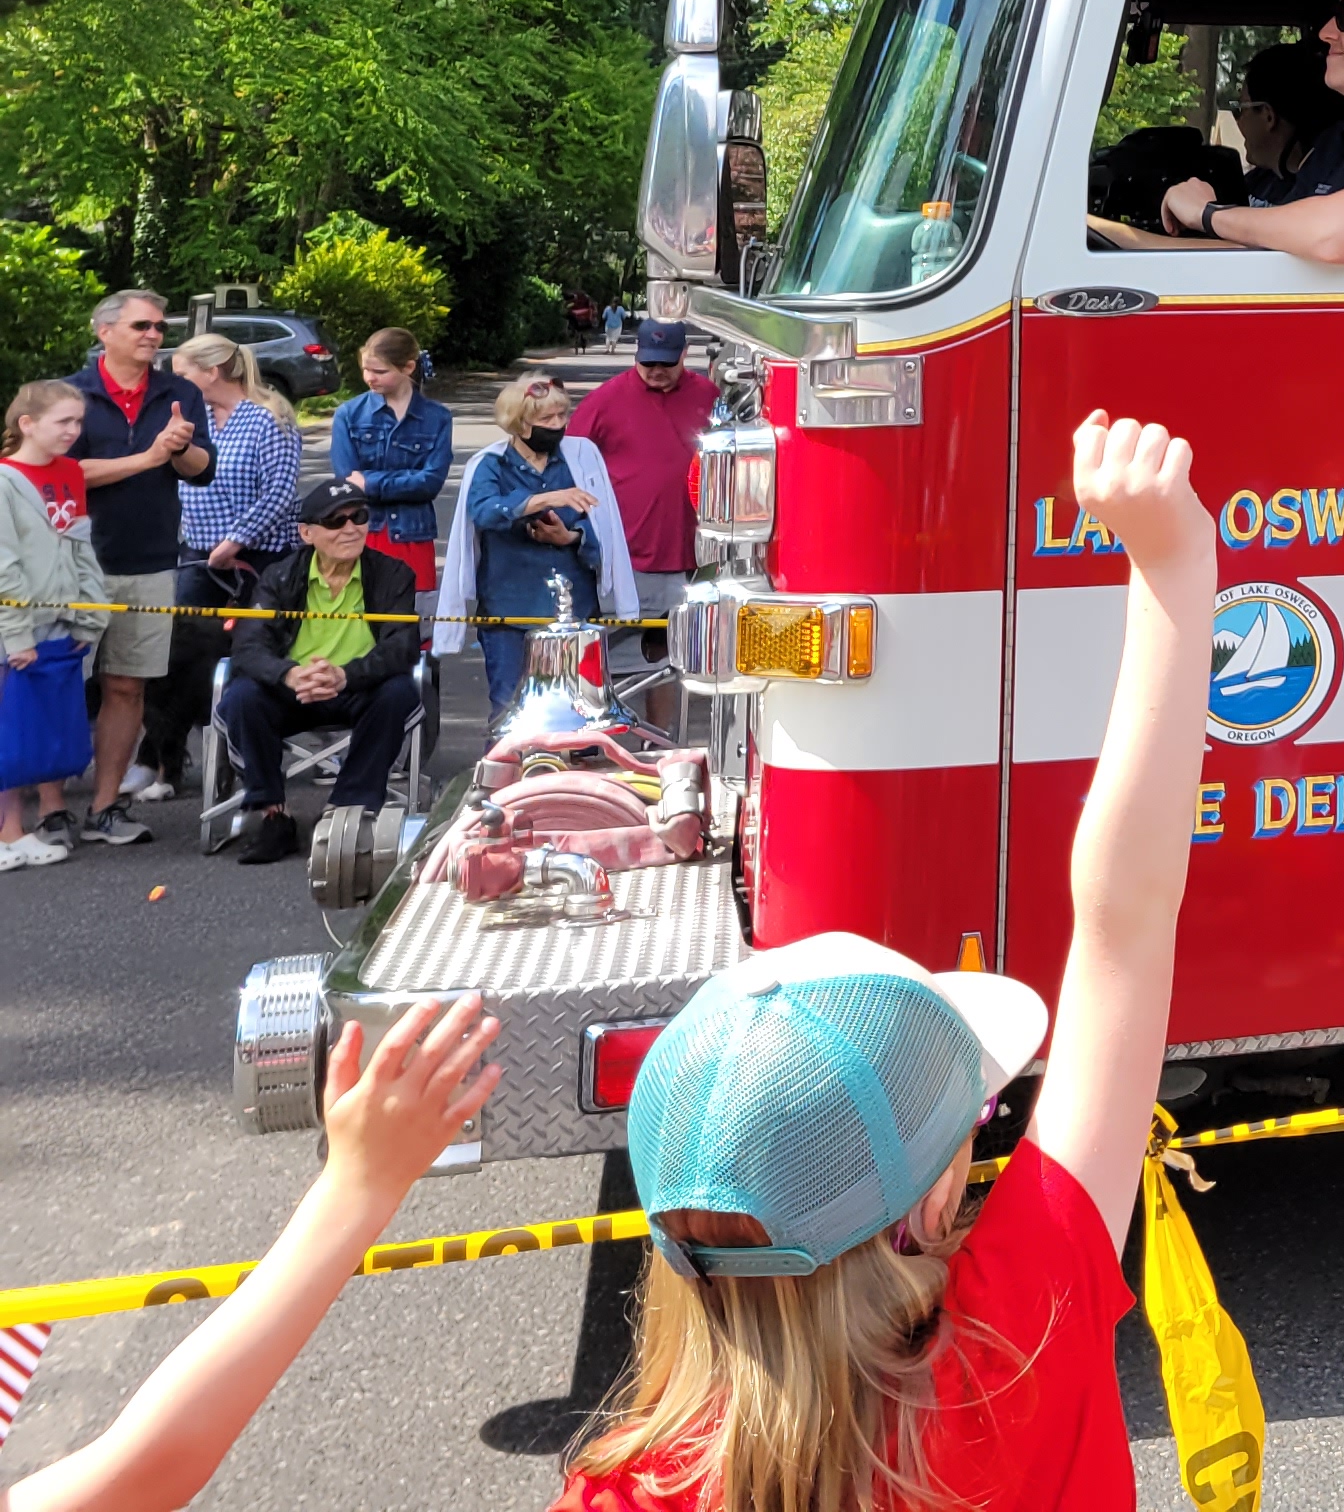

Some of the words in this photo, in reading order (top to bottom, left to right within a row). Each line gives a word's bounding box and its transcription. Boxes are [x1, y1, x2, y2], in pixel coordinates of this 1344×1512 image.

[1066, 291, 1127, 310] Dash
[1034, 495, 1124, 557] LA
[1219, 589, 1235, 603] OF
[1240, 585, 1270, 596] LAKE
[1274, 587, 1318, 620] OSWEGO
[1227, 728, 1277, 742] OREGON
